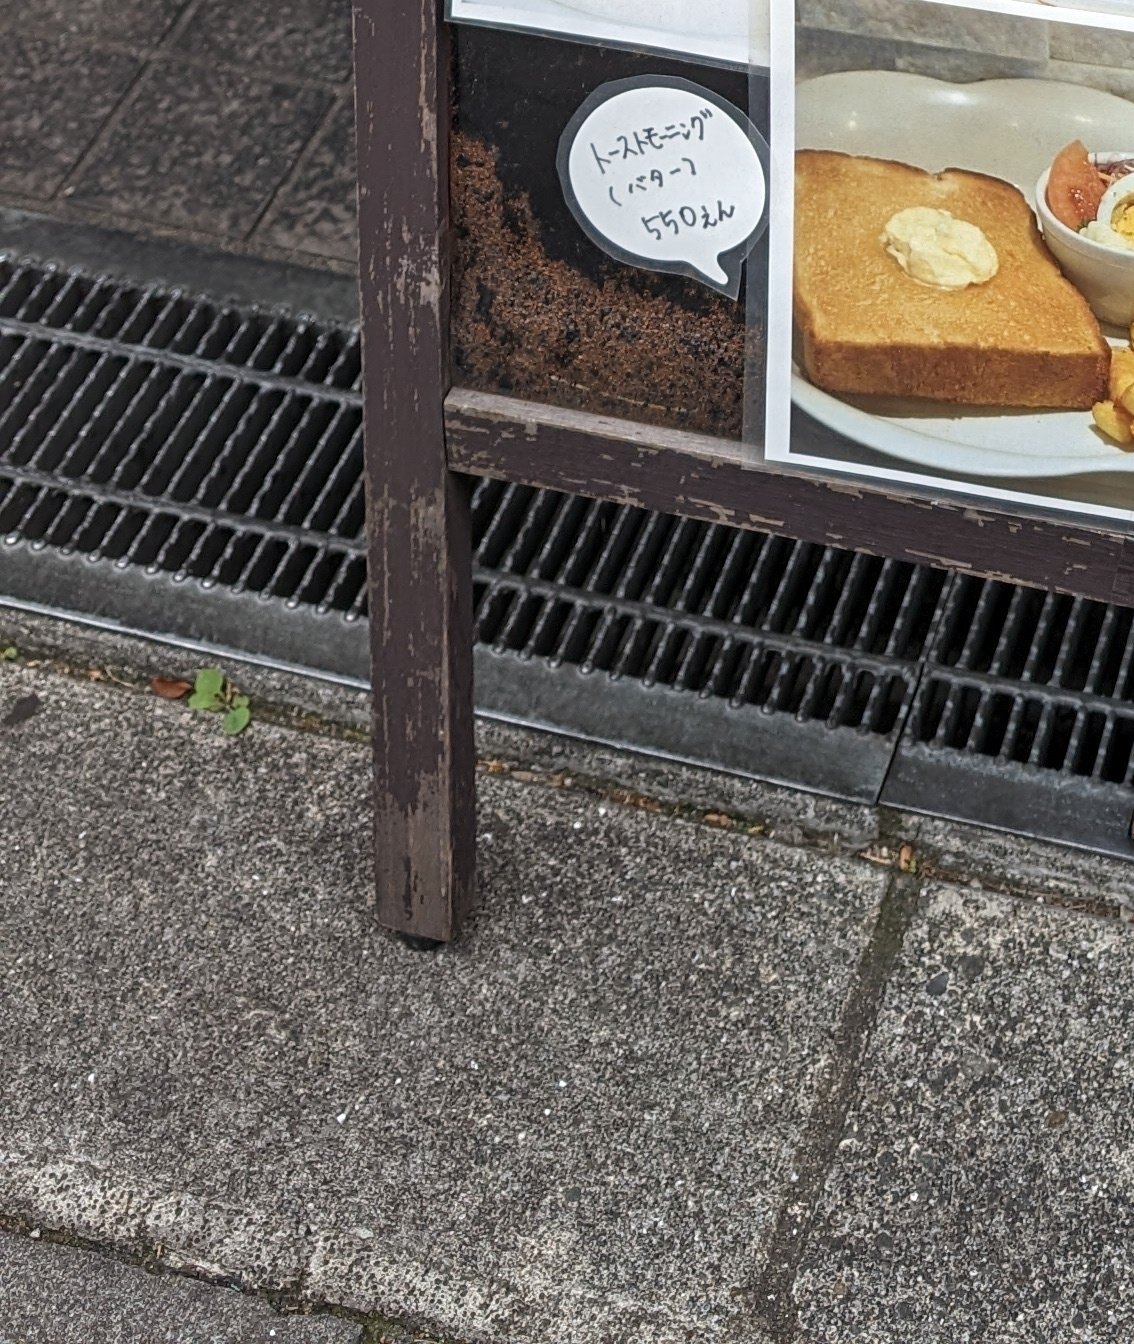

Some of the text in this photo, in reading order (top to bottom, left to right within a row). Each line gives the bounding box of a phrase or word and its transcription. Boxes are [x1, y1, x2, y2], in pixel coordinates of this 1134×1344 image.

[590, 108, 714, 175] トーストモーニング
[641, 200, 736, 241] 550えん
